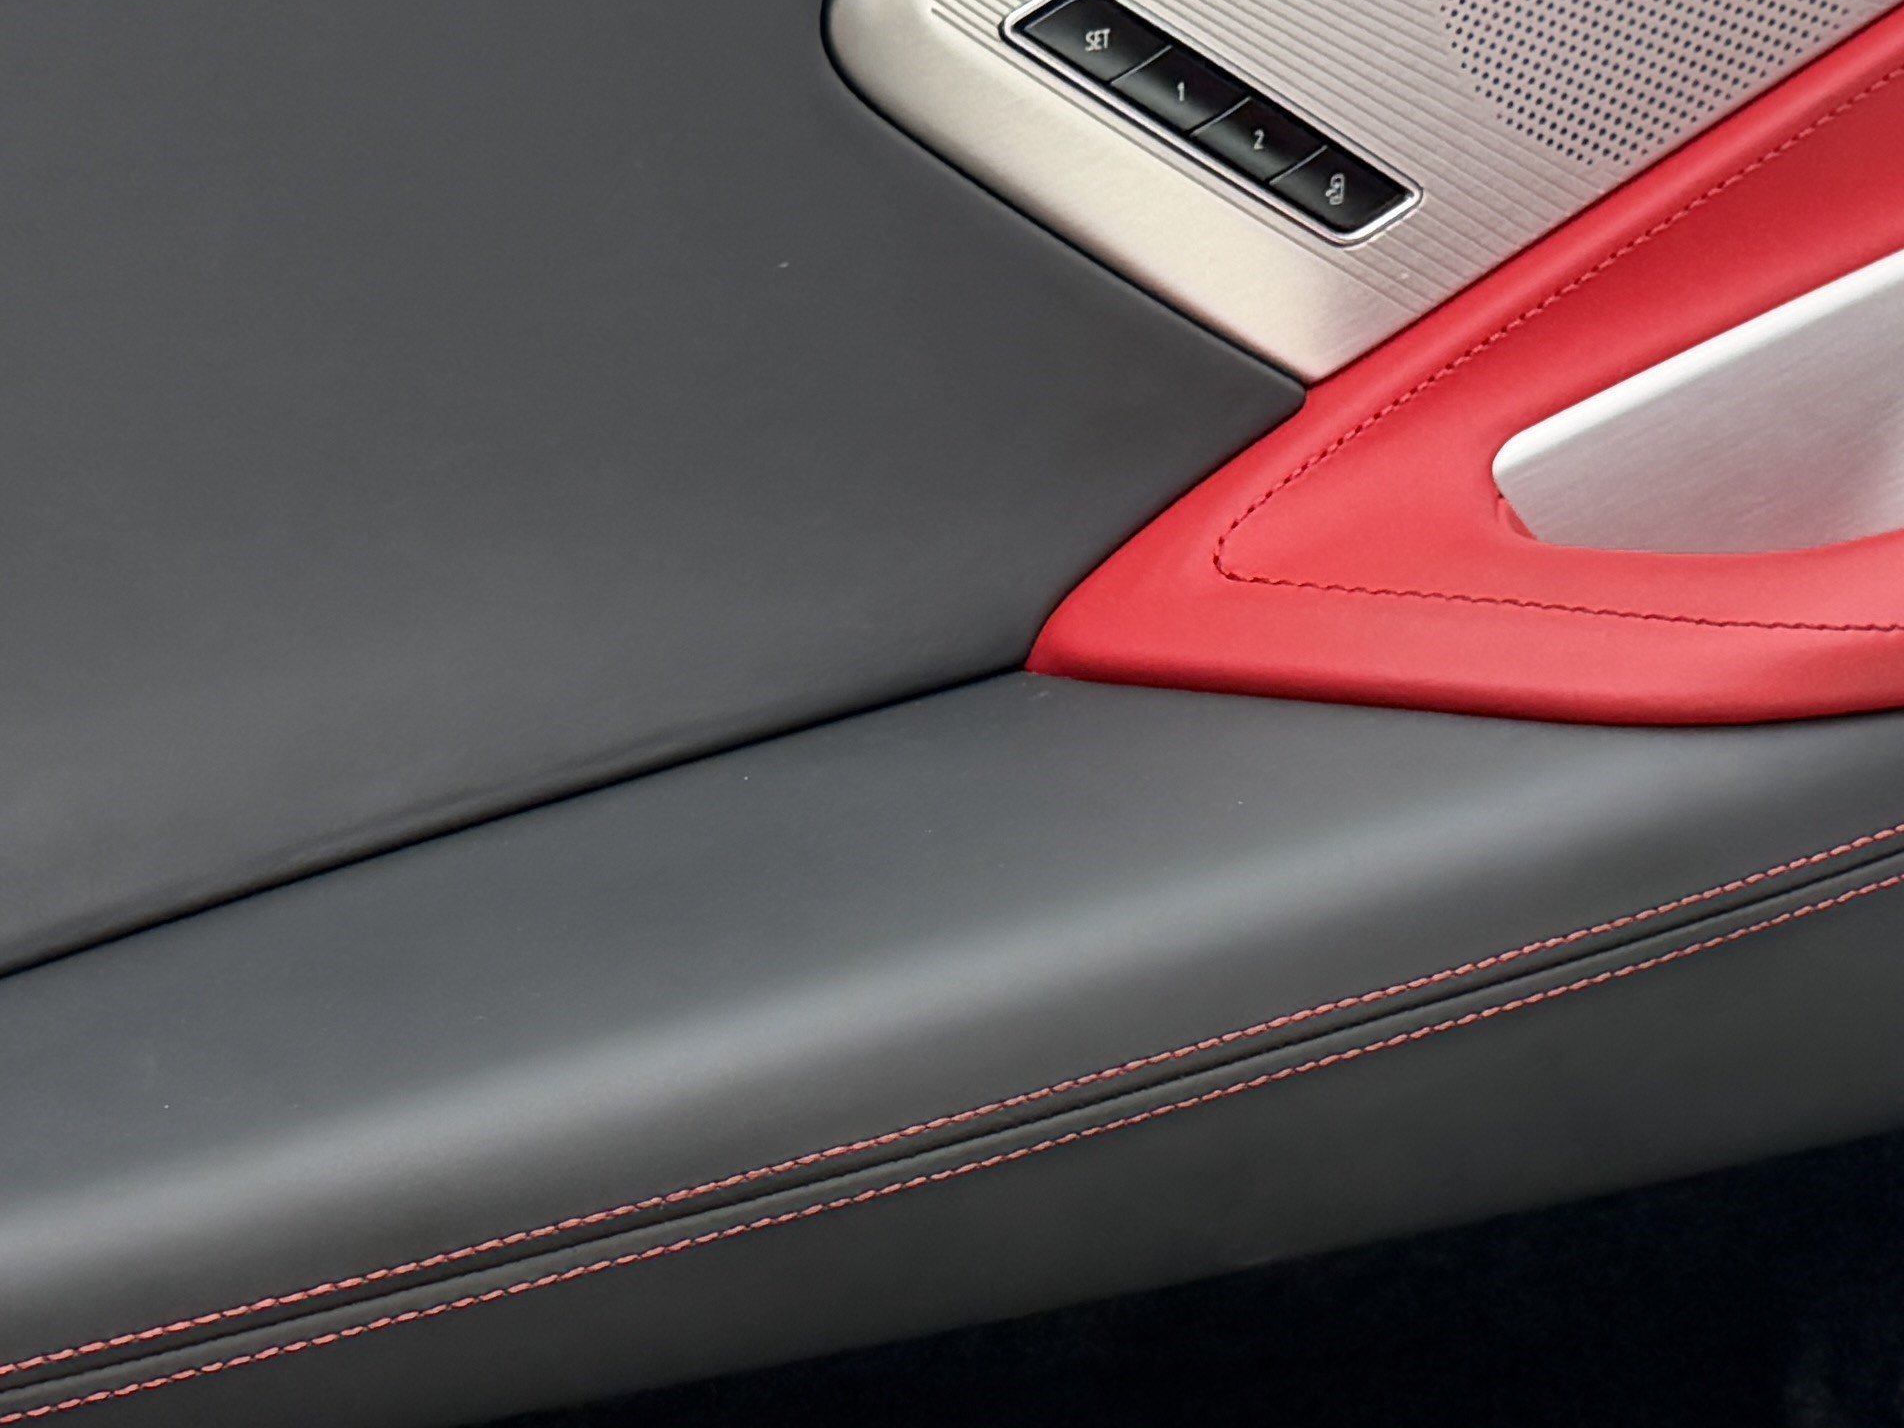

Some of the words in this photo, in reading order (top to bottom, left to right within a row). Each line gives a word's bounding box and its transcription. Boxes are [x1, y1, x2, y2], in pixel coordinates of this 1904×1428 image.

[1084, 28, 1111, 52] SET
[1176, 82, 1186, 102] 1
[1252, 129, 1266, 150] 2
